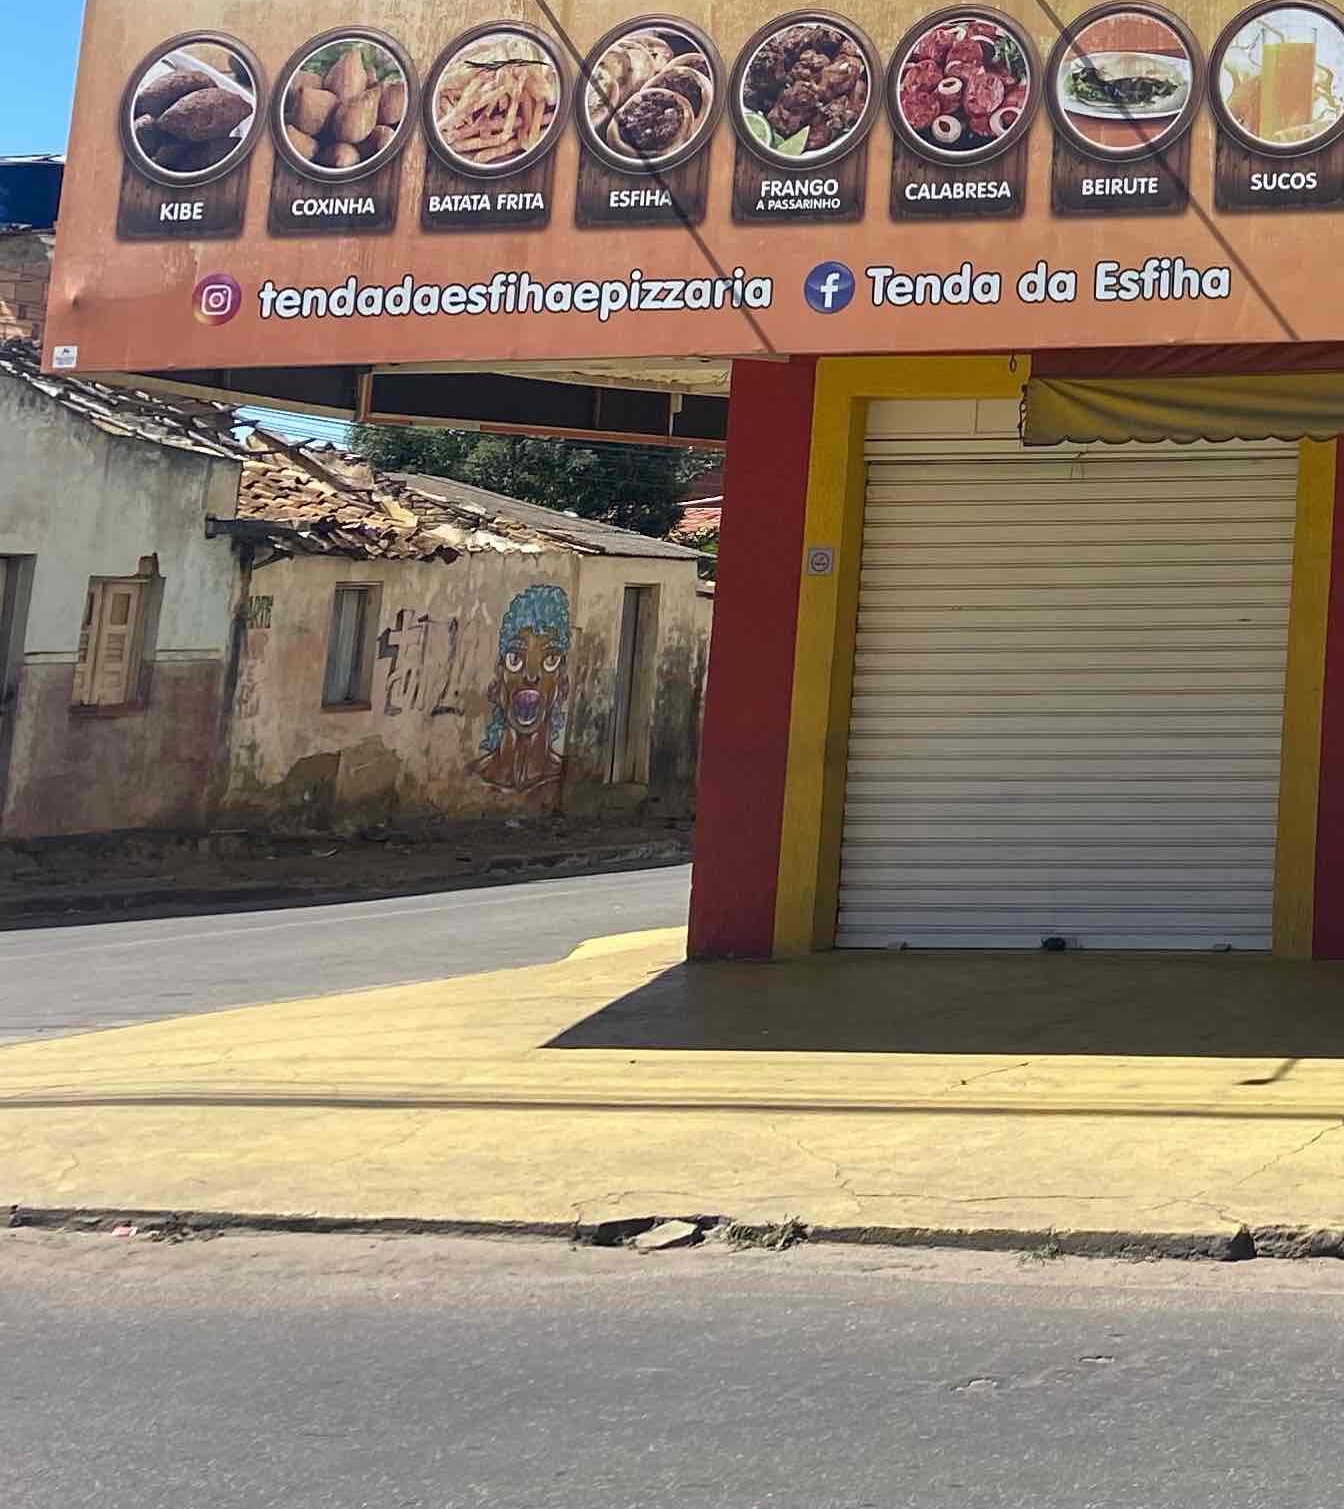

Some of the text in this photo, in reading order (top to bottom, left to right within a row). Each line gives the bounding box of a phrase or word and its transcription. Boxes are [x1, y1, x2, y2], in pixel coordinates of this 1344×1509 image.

[760, 178, 839, 199] FRANGO
[904, 181, 1011, 202] CALABRESA
[1081, 177, 1158, 196] BEIRUTE
[1250, 172, 1317, 191] SUCOS
[291, 196, 375, 217] COXINHA
[428, 191, 544, 214] BATATA FRITA
[608, 190, 672, 209] ESFIHA
[755, 197, 841, 210] A PASSARINHO
[158, 201, 204, 222] KIBE
[865, 260, 1002, 308] Tenda
[1017, 258, 1078, 304] da
[1094, 255, 1232, 302] Esfiha
[258, 268, 774, 321] tendadaesfihaepizzaria
